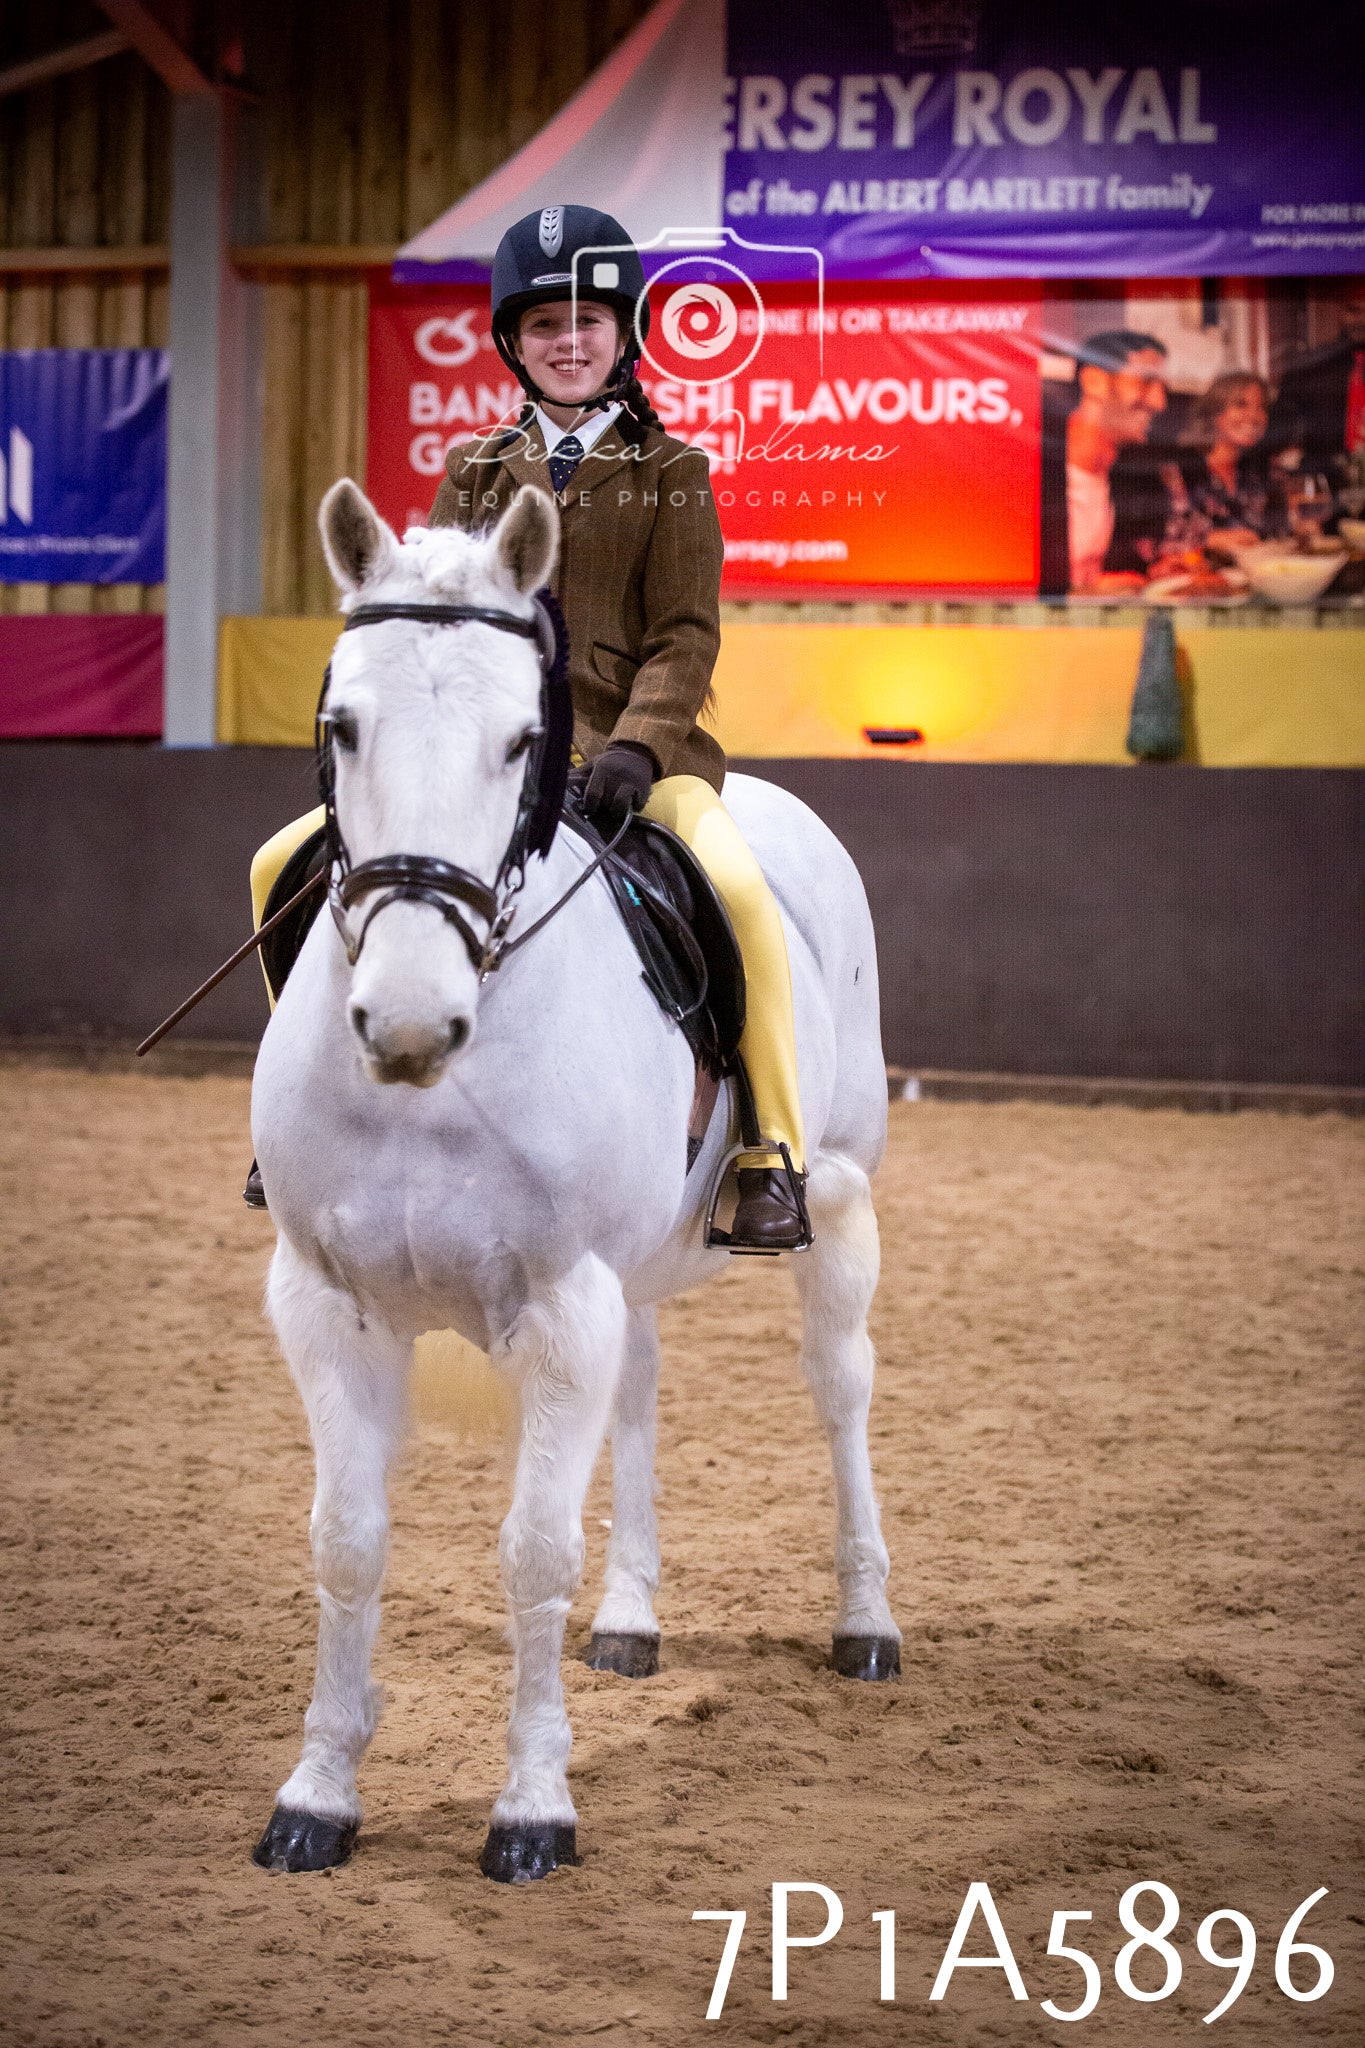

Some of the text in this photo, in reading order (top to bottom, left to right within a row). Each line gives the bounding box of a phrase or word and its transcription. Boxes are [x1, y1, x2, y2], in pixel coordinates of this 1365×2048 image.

[953, 67, 1218, 146] ROYAL
[725, 173, 1214, 219] of the ALBERT BARTLETT family
[840, 307, 884, 334] OR
[887, 305, 1029, 334] TAKEAWAY
[748, 377, 1024, 428] FLAVOURS,
